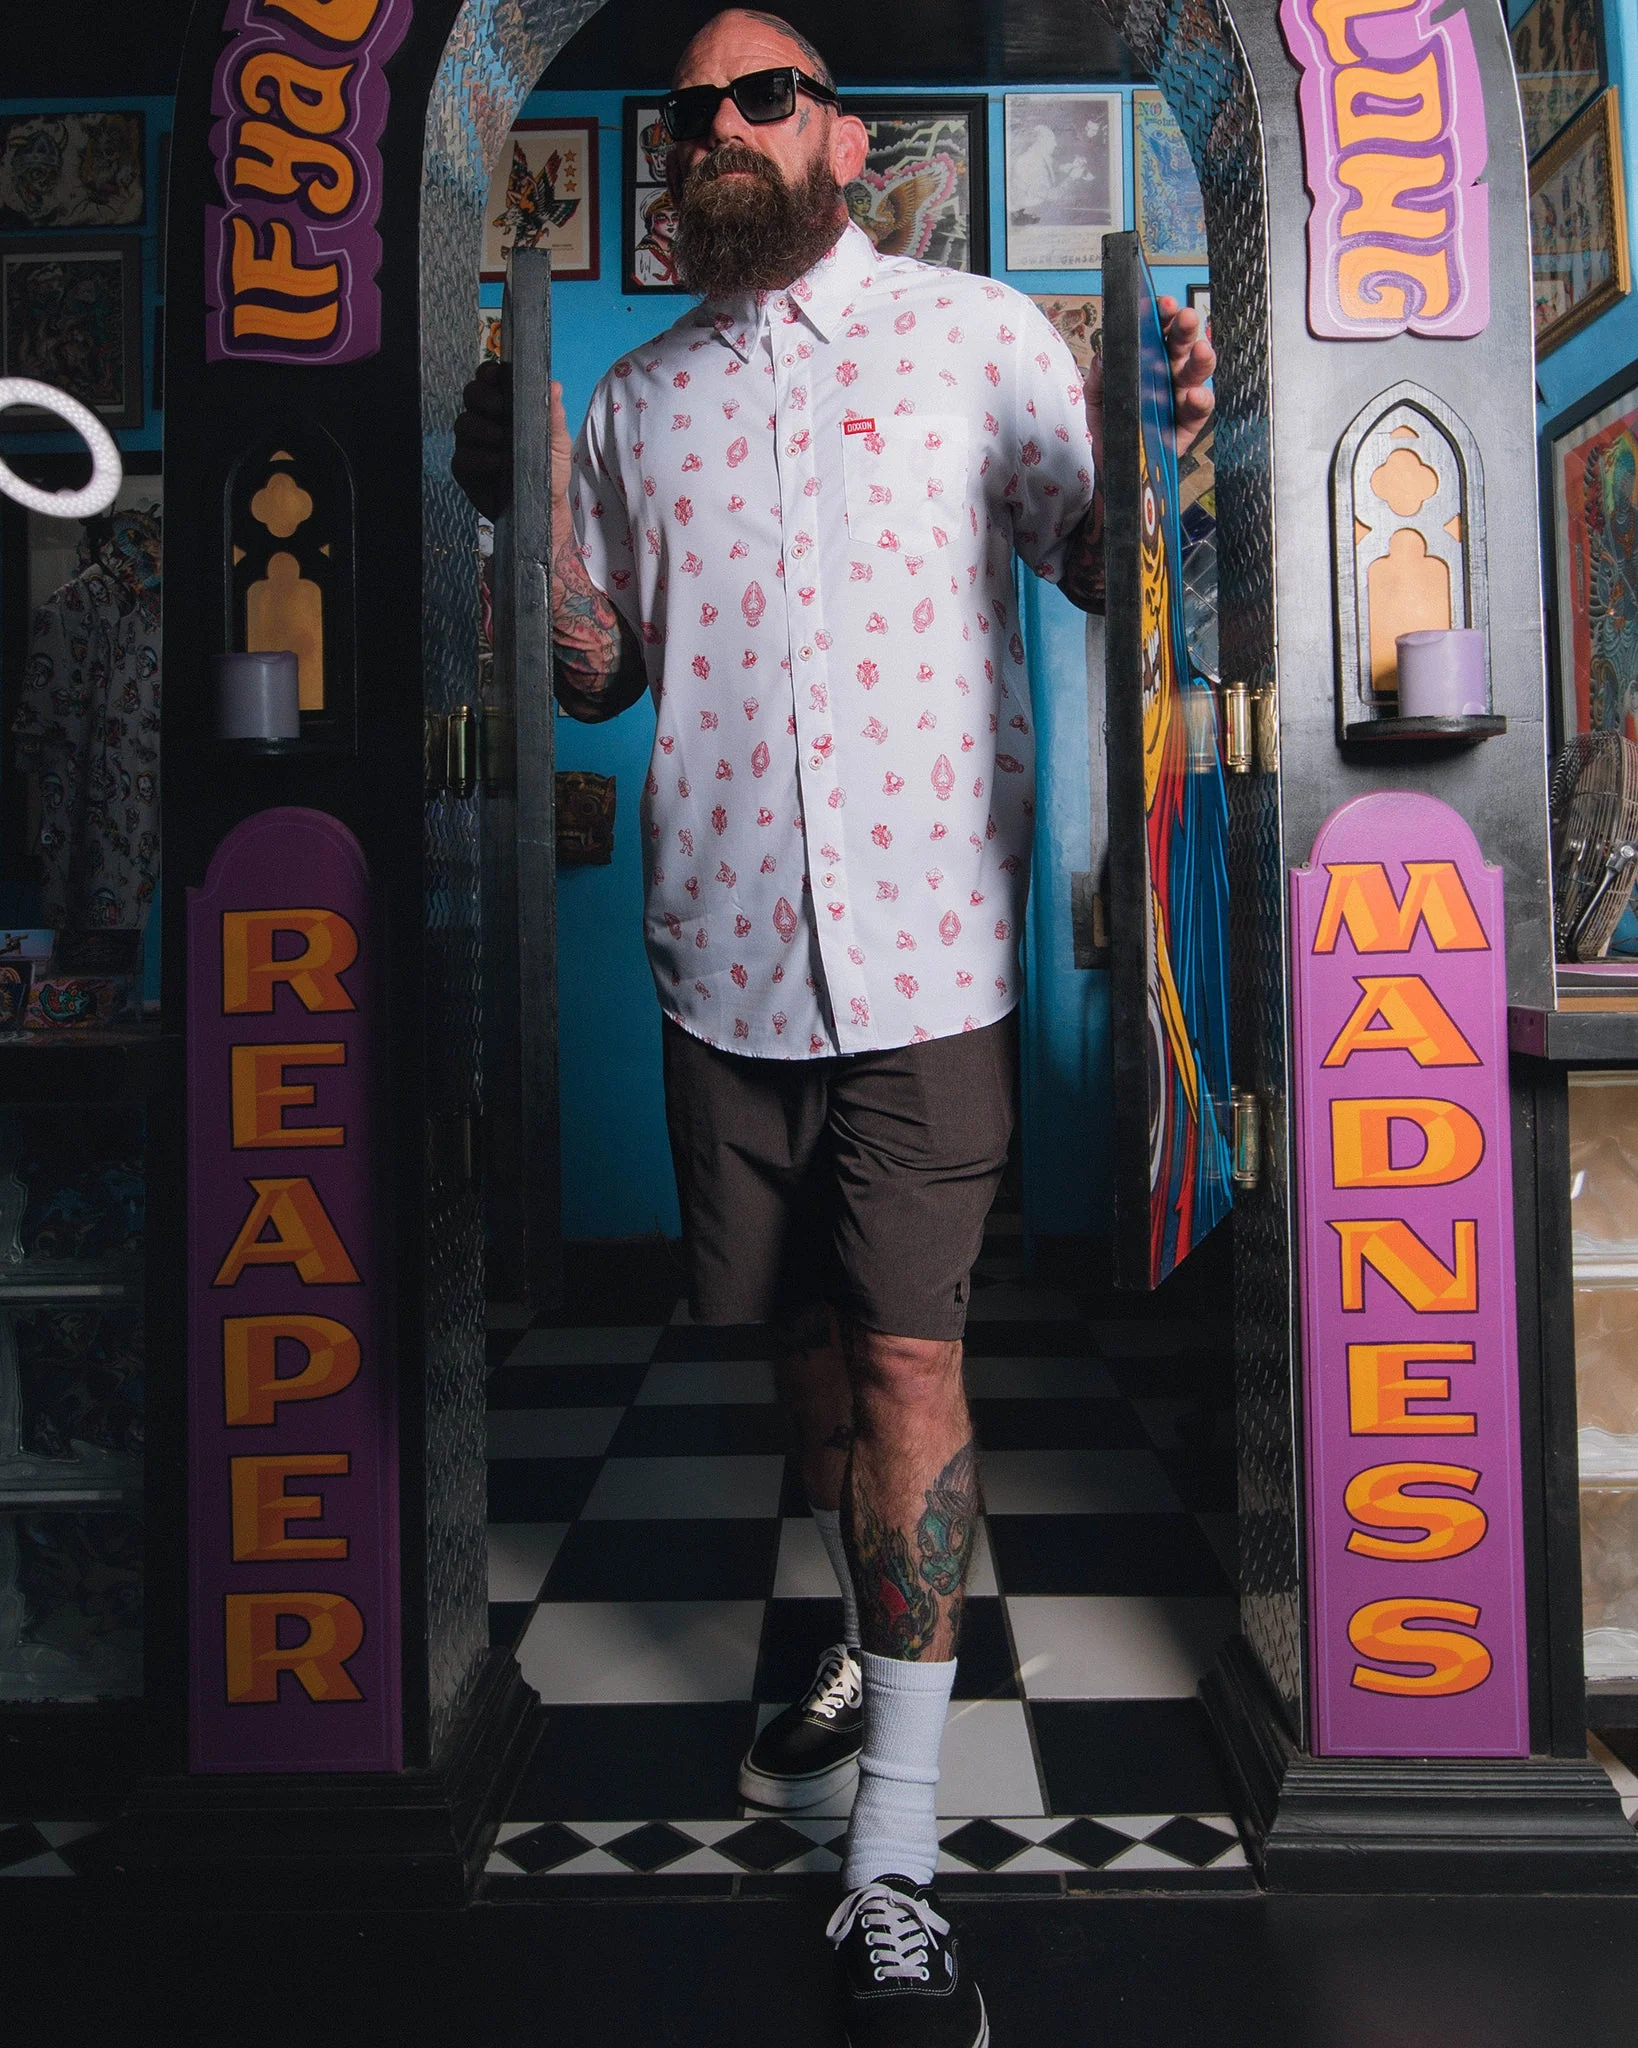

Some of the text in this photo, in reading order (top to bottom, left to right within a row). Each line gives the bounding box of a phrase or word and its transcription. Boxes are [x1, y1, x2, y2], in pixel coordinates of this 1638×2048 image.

[847, 421, 873, 432] DIXXON
[211, 907, 367, 1705] REAPER
[1310, 861, 1494, 1699] MADNESS
